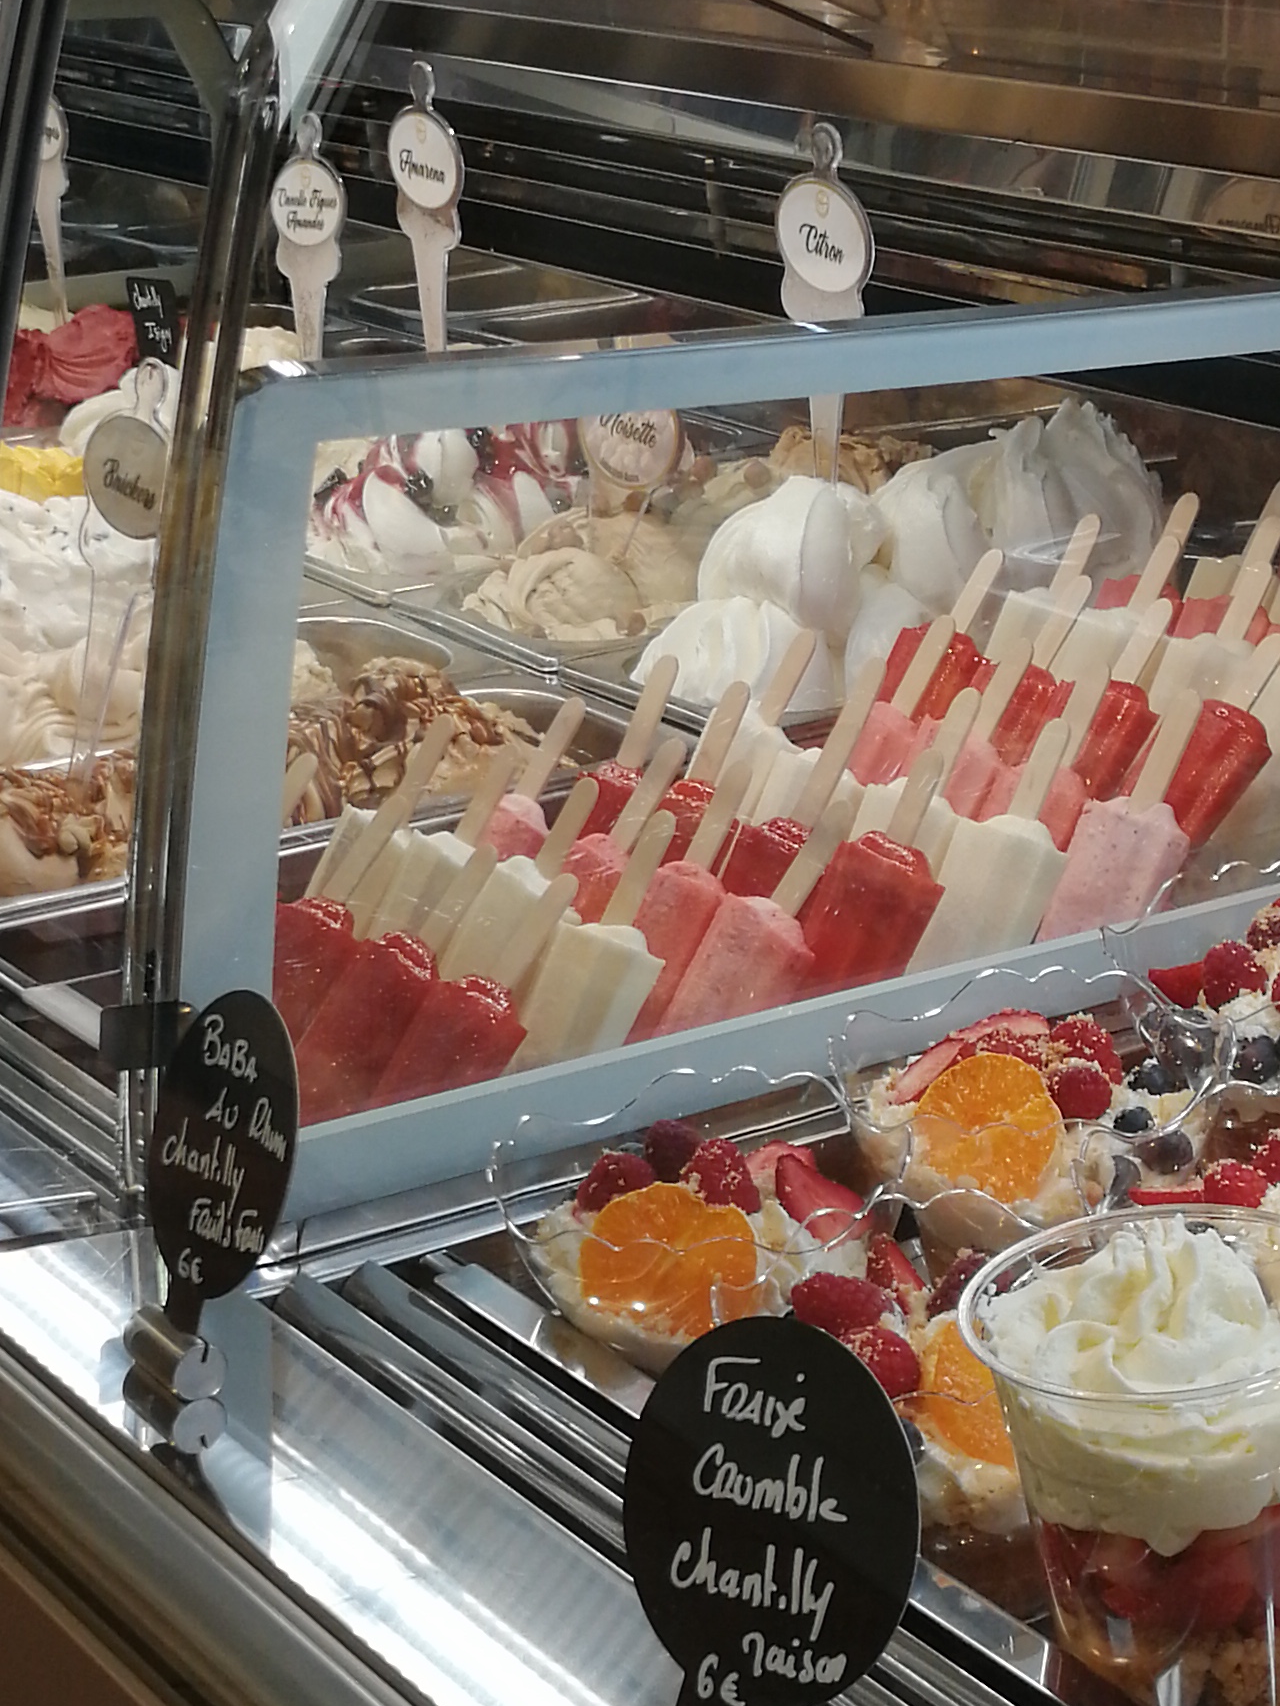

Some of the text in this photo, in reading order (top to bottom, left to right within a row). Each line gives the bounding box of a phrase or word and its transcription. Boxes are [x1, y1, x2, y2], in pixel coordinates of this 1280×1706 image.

[399, 148, 447, 185] Amarena
[799, 223, 846, 266] Citron
[177, 1246, 204, 1285] 6€
[692, 1442, 849, 1523] Crumble
